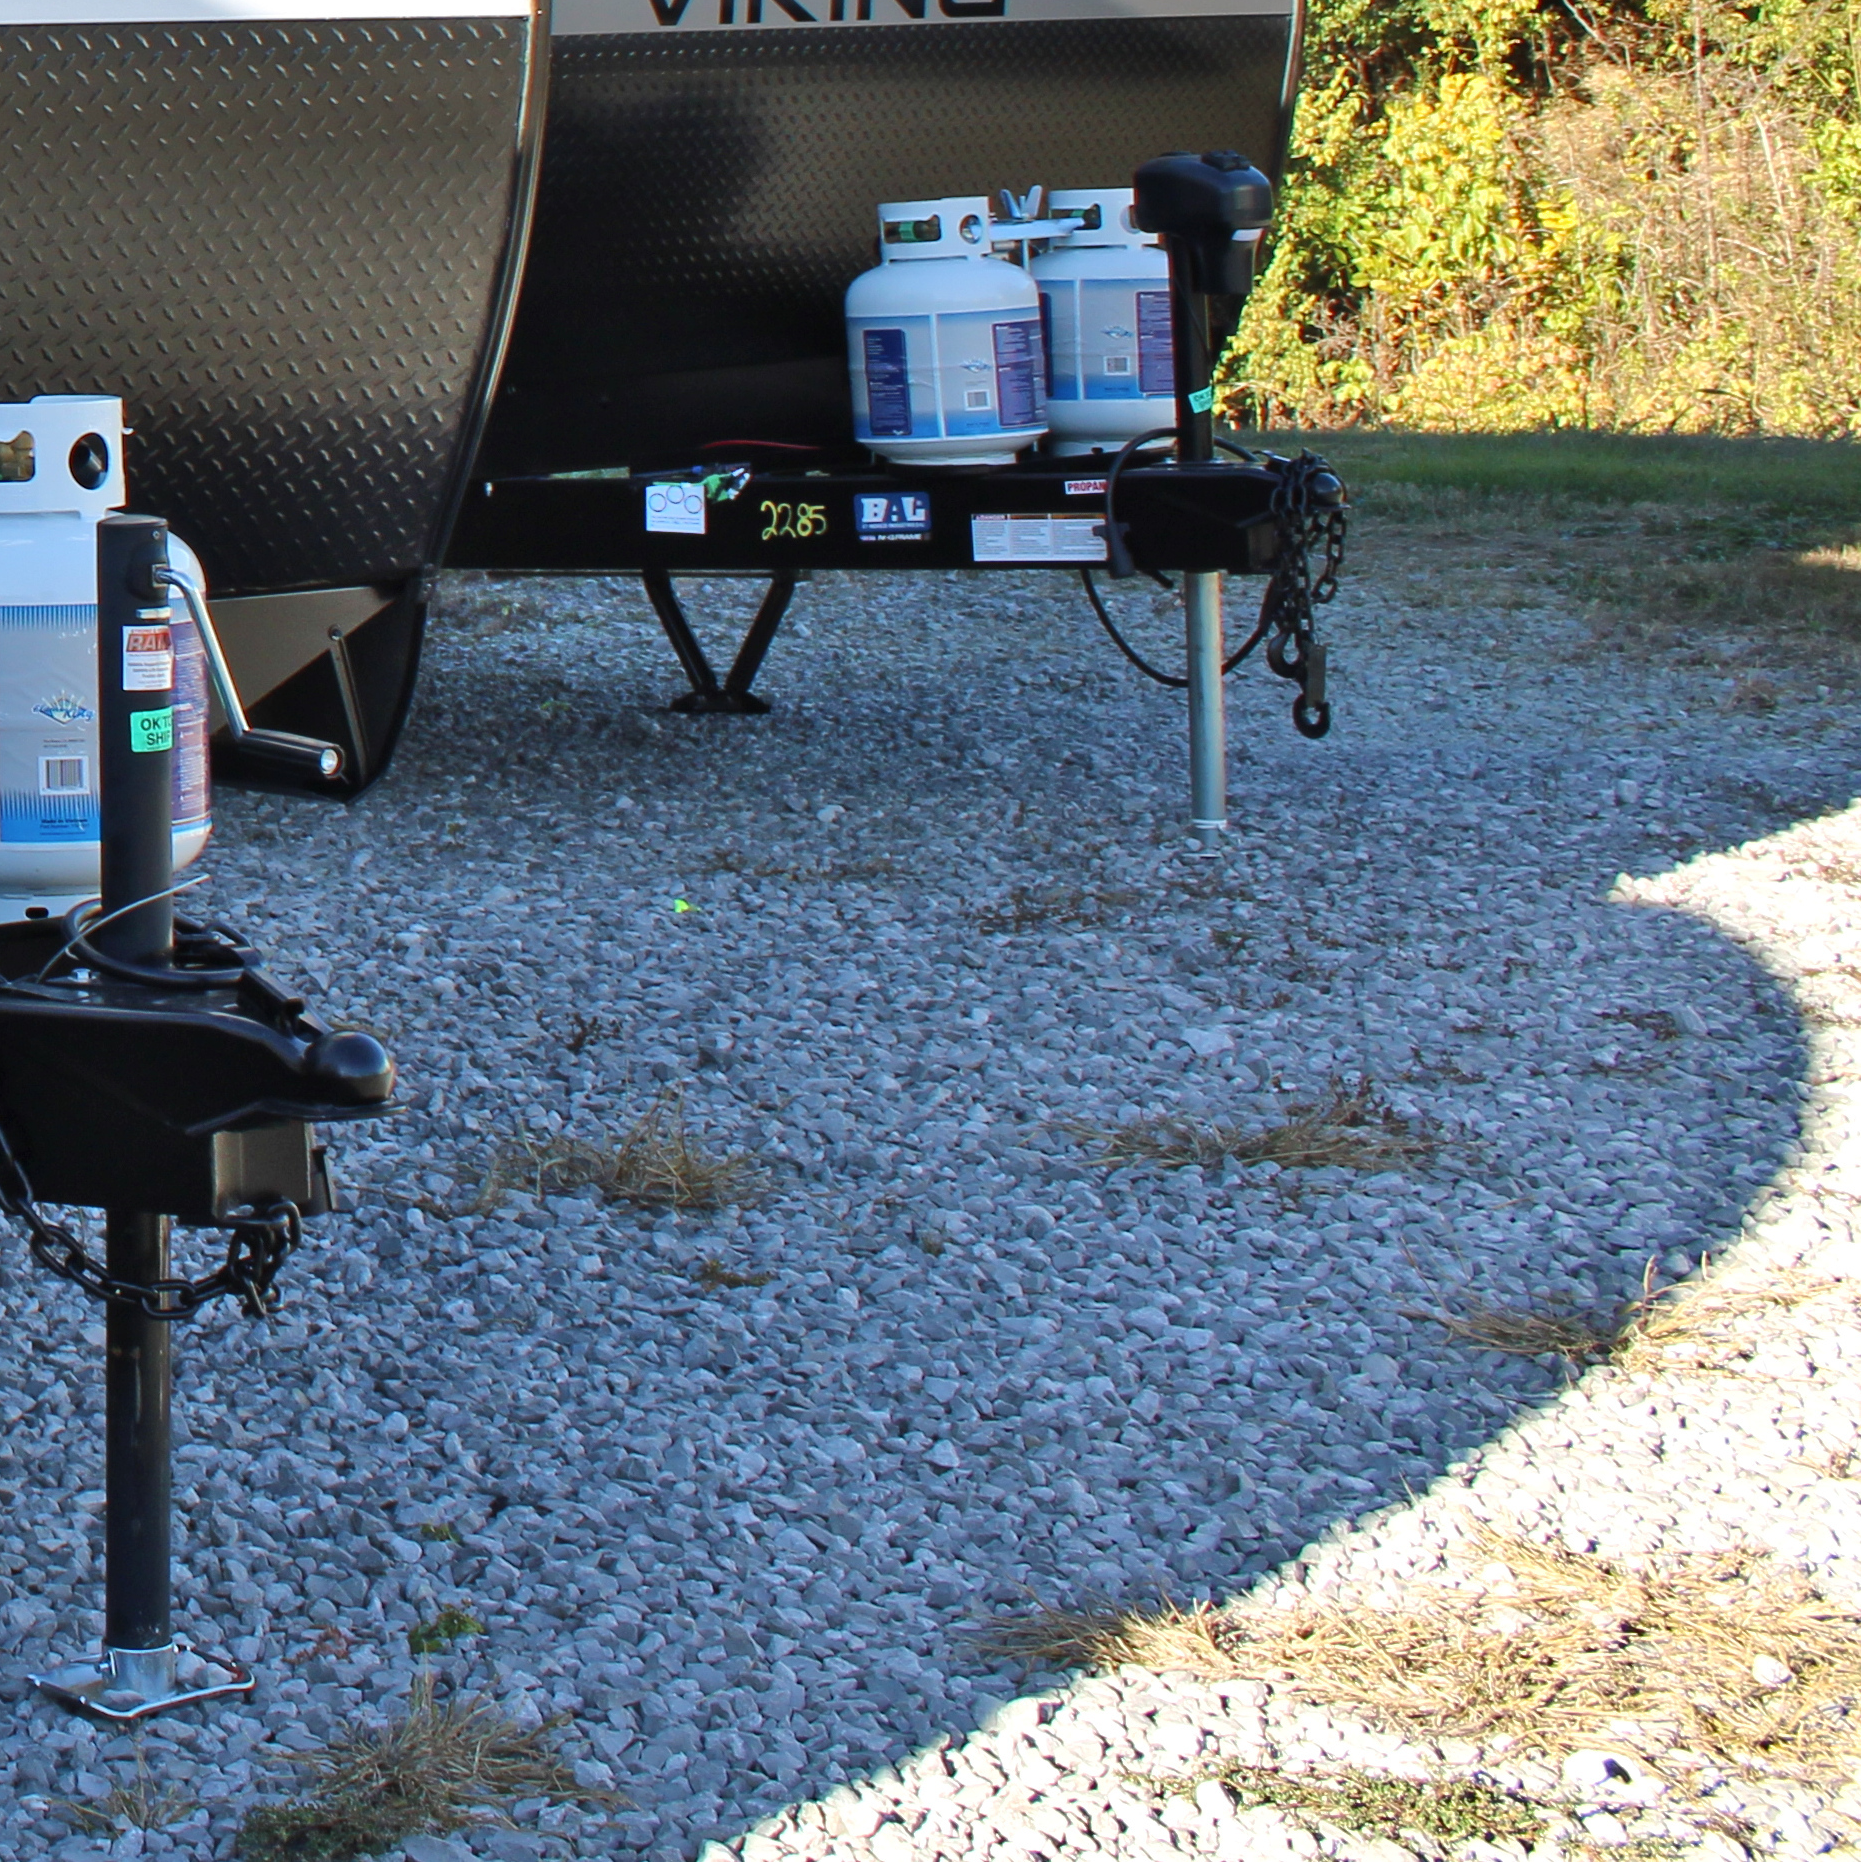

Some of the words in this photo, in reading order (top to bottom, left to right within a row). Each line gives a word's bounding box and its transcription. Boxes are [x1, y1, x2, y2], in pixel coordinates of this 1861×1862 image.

[760, 500, 827, 541] 2285
[860, 496, 926, 523] BAL
[140, 716, 163, 731] OK
